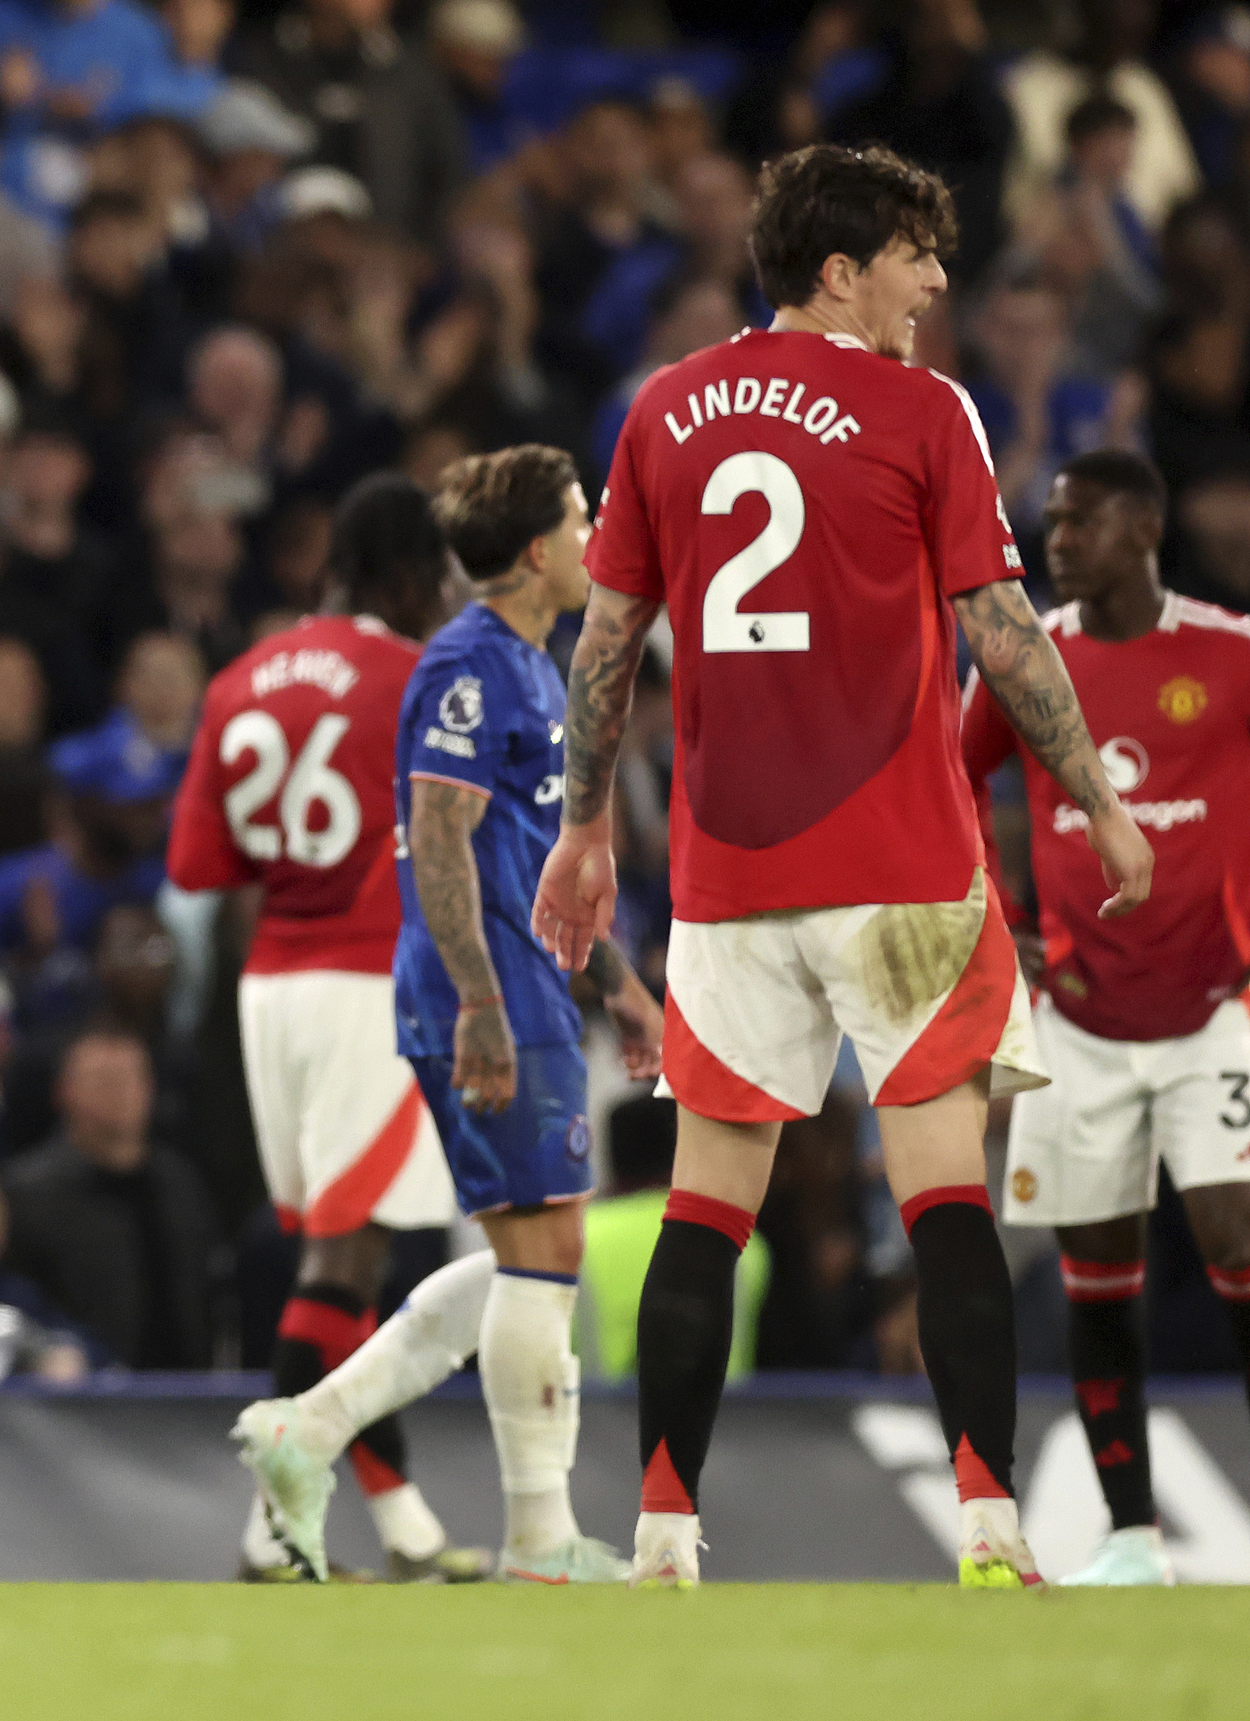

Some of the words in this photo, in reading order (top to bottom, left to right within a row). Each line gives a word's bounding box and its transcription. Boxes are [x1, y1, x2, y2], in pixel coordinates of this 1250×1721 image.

[664, 376, 862, 446] LINDELOF
[700, 450, 810, 653] 2
[218, 708, 363, 870] 26
[1219, 1069, 1250, 1132] 3
